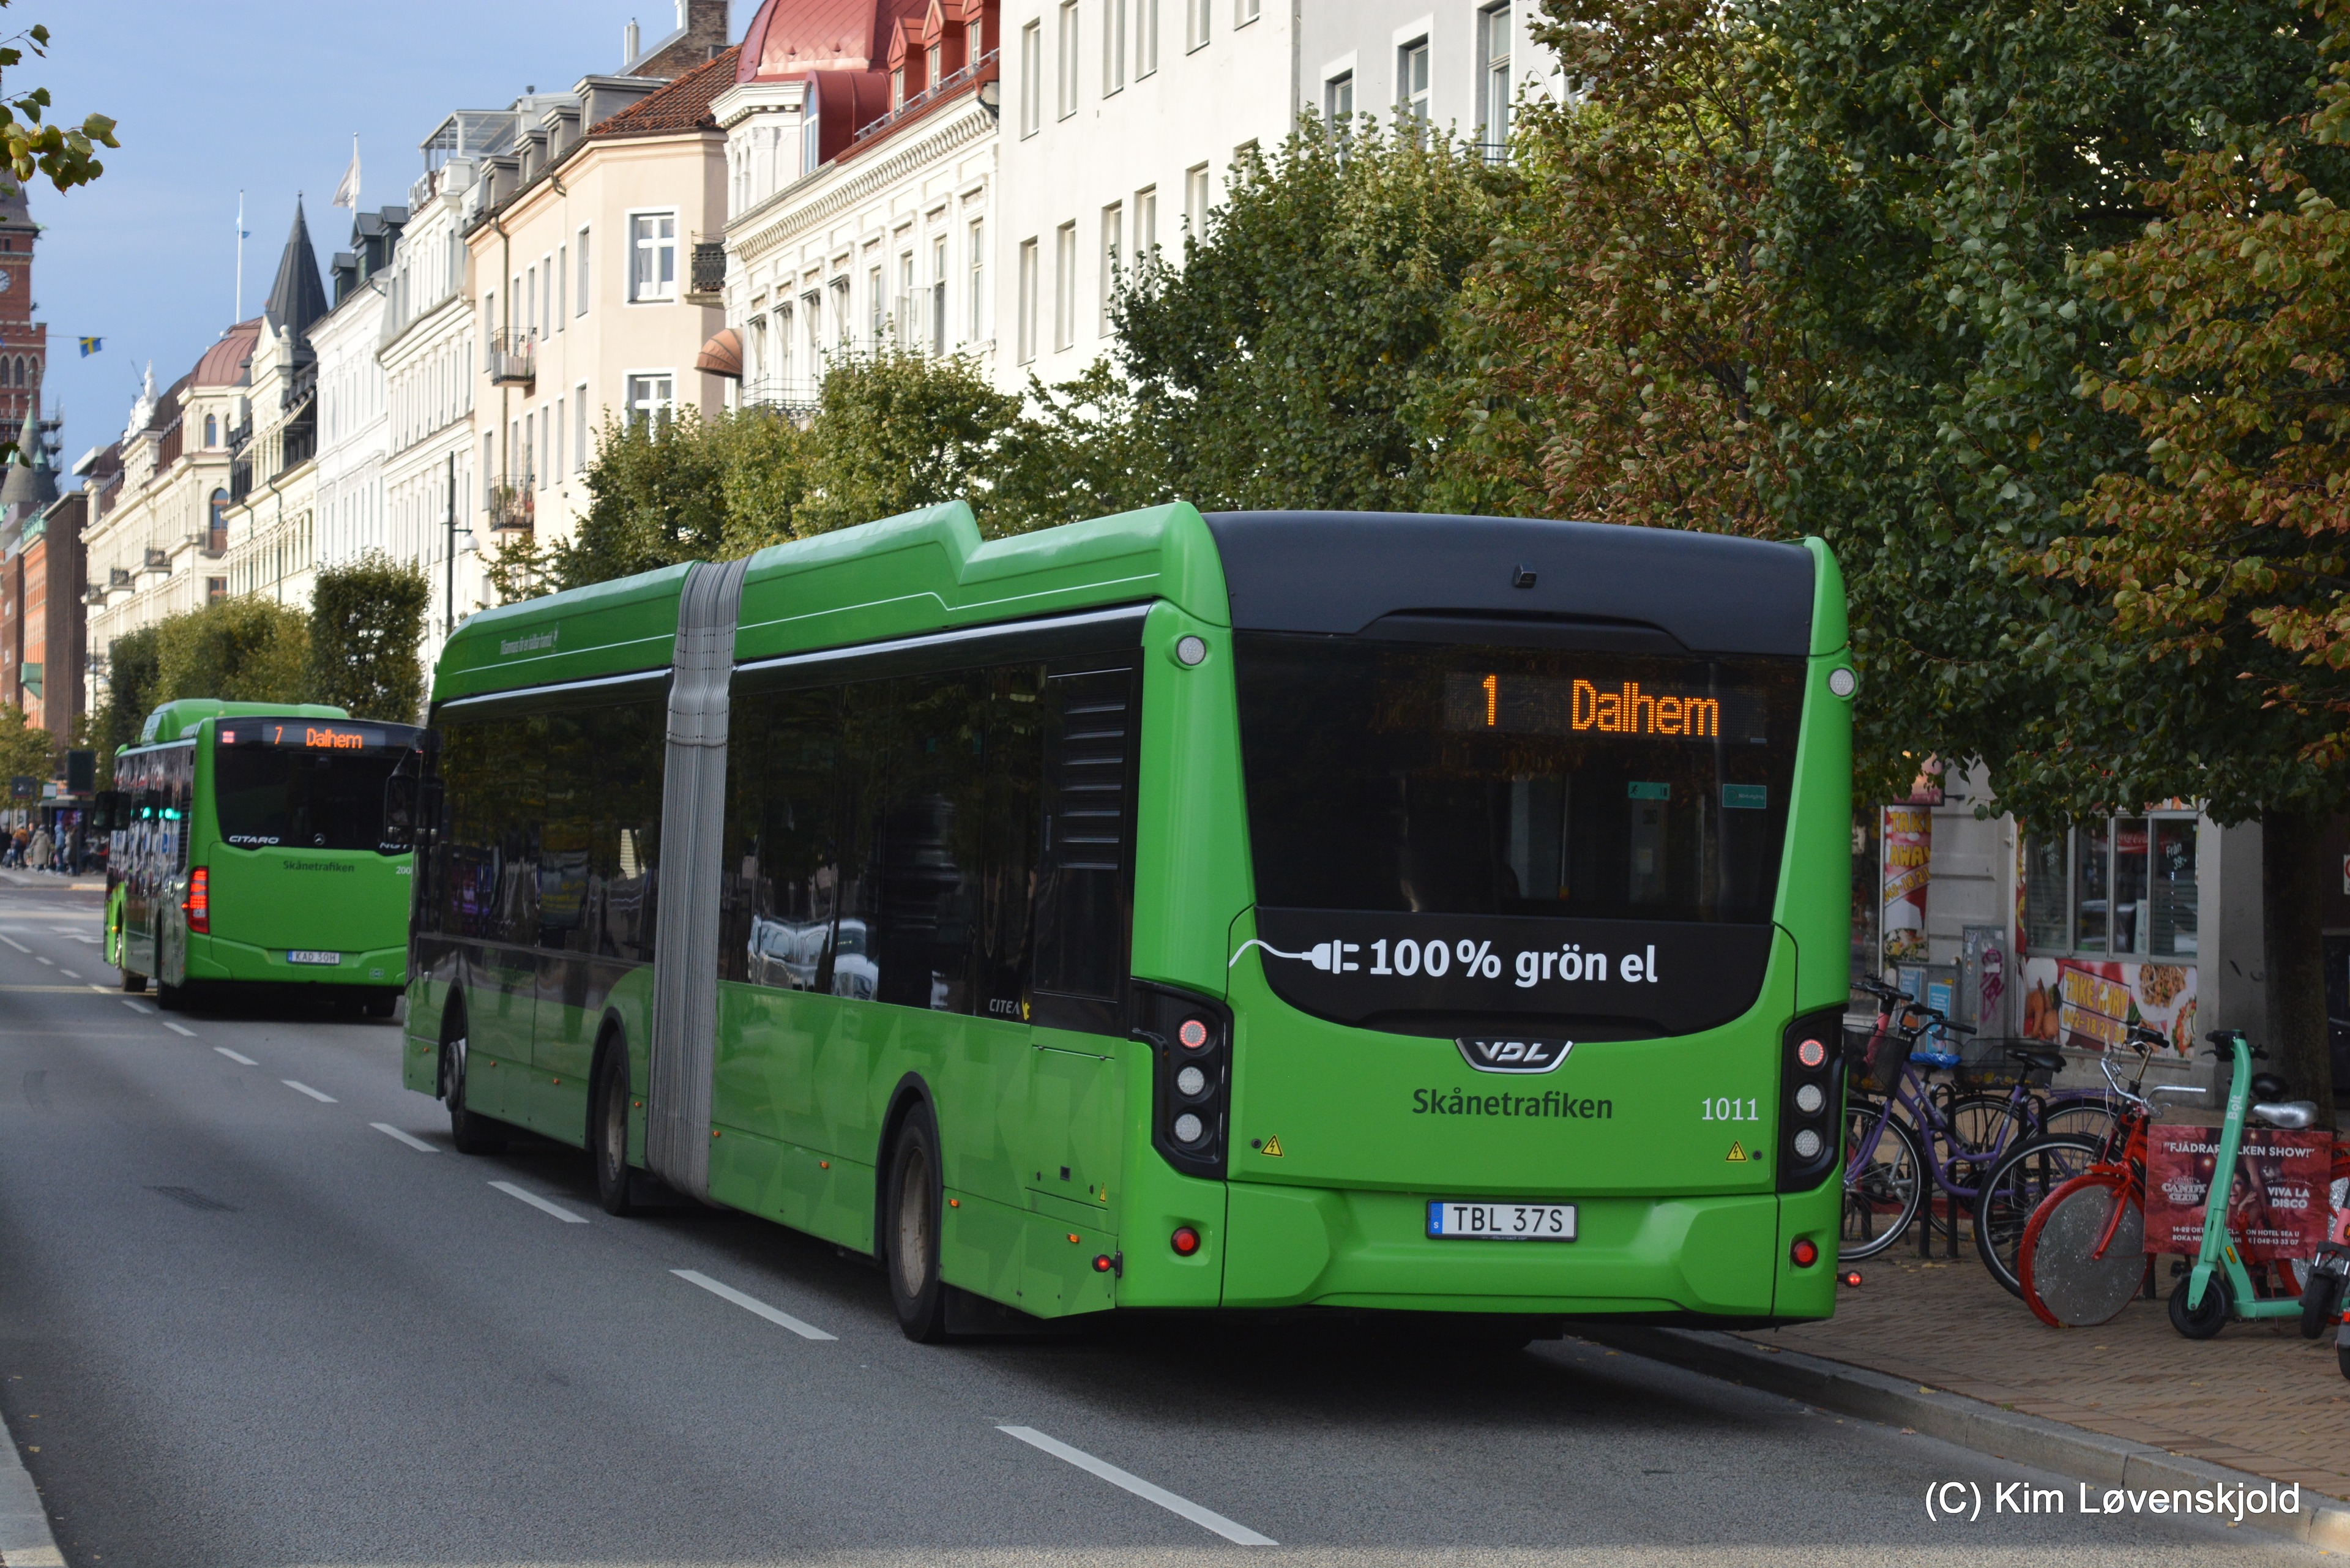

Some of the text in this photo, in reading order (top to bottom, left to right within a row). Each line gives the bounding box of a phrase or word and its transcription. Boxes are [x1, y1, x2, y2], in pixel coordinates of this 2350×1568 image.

[1483, 675, 1719, 736] 1 Dalhem
[275, 726, 362, 749] 7 Dalhem
[228, 835, 280, 845] CITARO
[2166, 842, 2183, 857] Från
[283, 860, 355, 873] Skånetrafiken
[1515, 944, 1607, 988] grön
[1620, 945, 1658, 982] el
[2065, 971, 2095, 1009] TAKE
[1475, 1042, 1550, 1062] VDL
[1412, 1088, 1759, 1121] Skånetrafiken 1011
[2227, 1095, 2243, 1120] Bolt
[2267, 1187, 2310, 1198] VIVA LA
[2272, 1198, 2308, 1209] DISCO
[1453, 1206, 1563, 1233] TBL 37S
